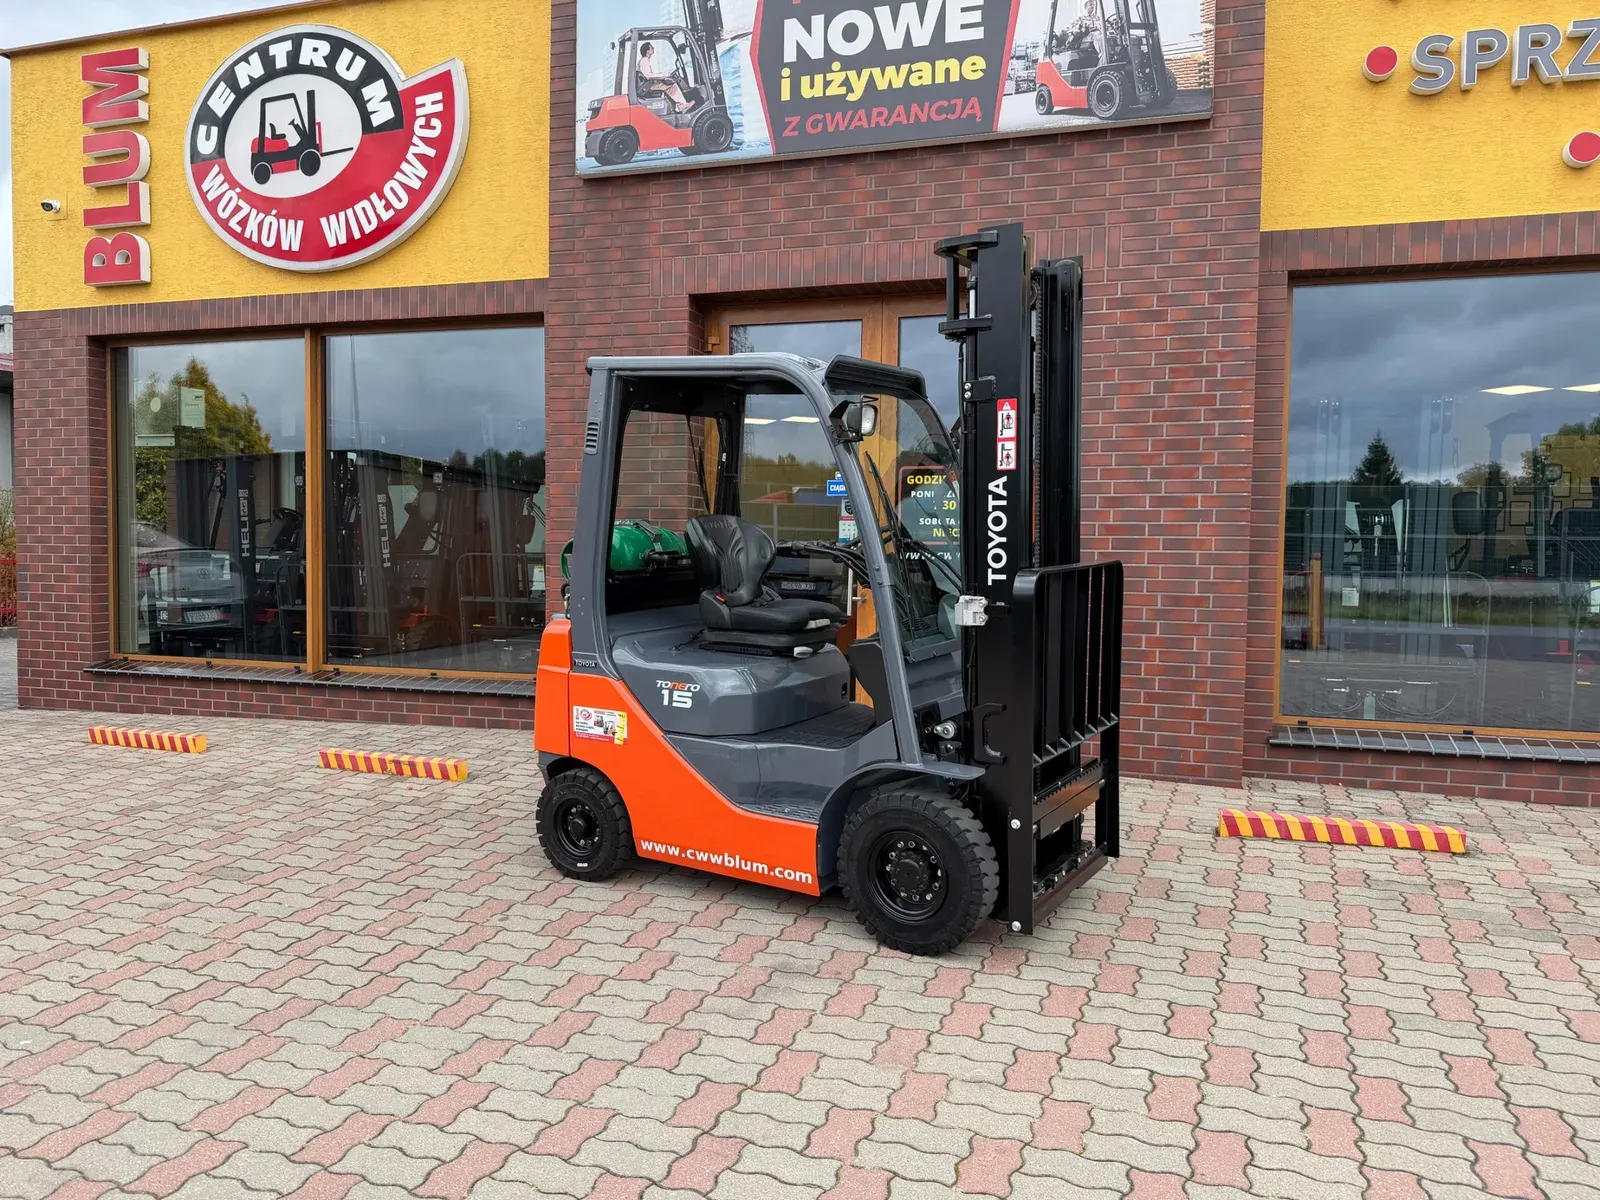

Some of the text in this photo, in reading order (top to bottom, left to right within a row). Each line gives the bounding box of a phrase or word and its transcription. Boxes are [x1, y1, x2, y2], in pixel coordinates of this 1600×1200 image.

[784, 0, 985, 63] NOWE
[1408, 17, 1600, 96] SPRZ
[197, 38, 396, 155] CENTRUM
[781, 55, 987, 102] i używane
[782, 97, 982, 137] Z GWARANCJĄ
[81, 47, 151, 288] BLUM
[200, 91, 444, 252] WÓZKÓW WIDŁOWYCH
[987, 475, 1008, 586] TOYOTA
[575, 660, 597, 668] TOYOTA
[661, 690, 693, 709] 15
[640, 840, 813, 885] www.cwwblum.com
